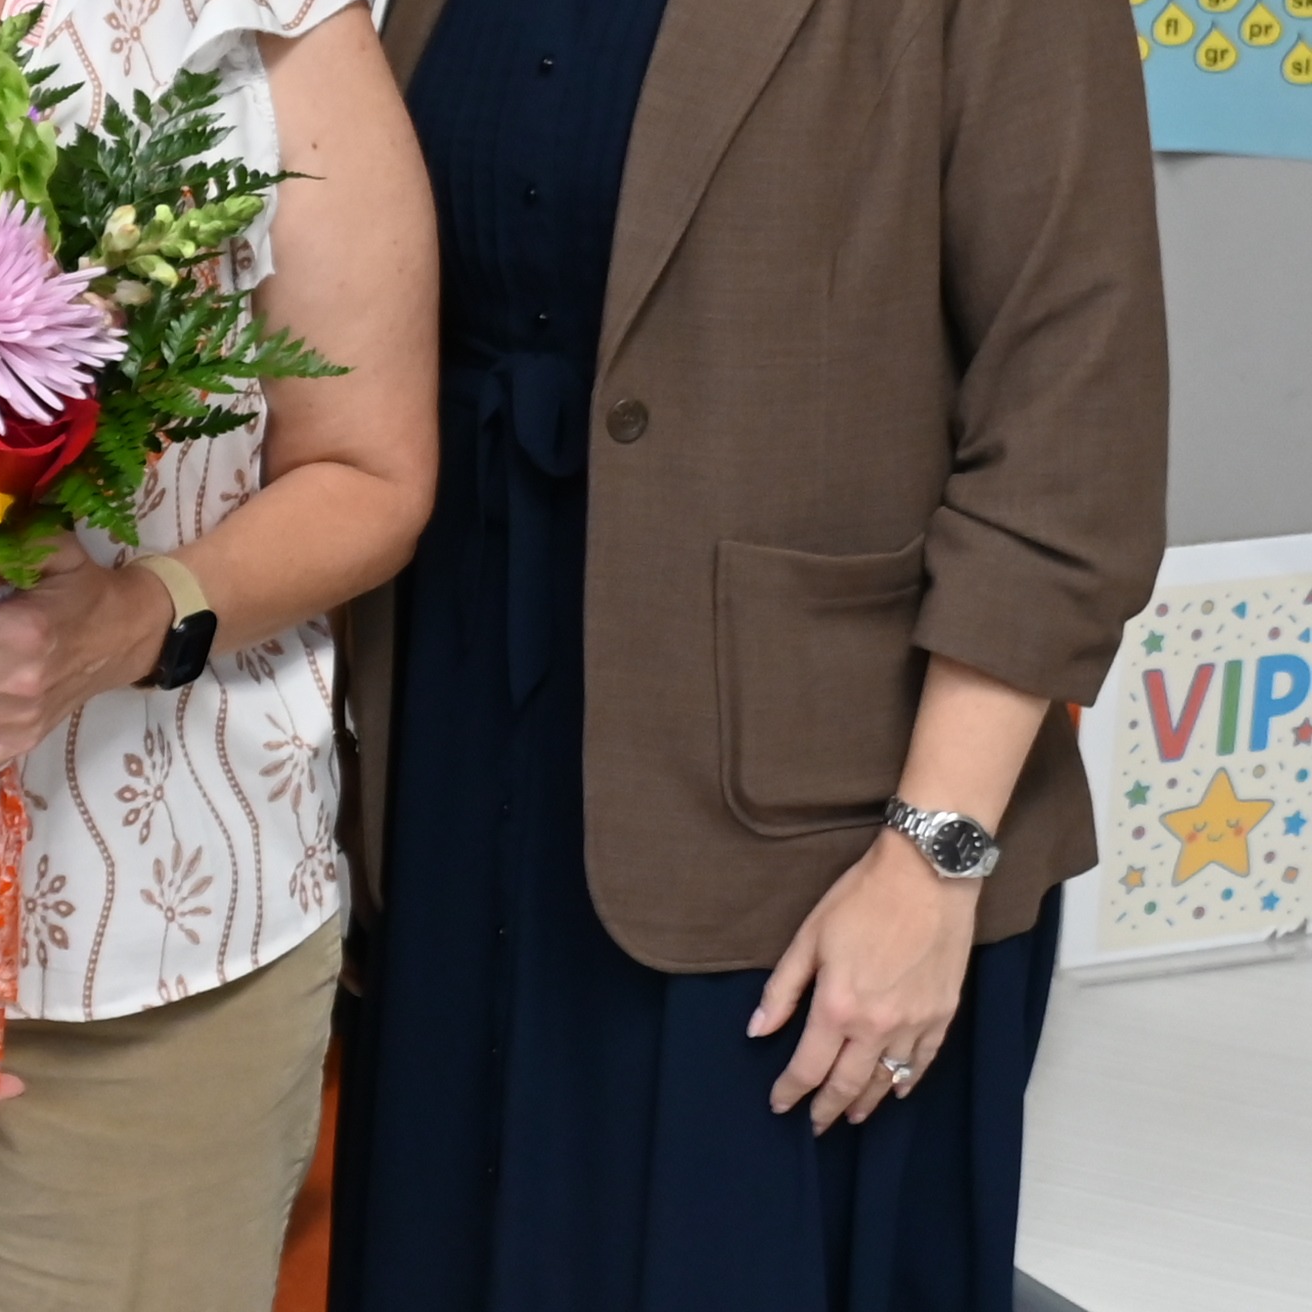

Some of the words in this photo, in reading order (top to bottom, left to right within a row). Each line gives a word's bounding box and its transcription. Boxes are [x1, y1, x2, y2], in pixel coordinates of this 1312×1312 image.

[1165, 19, 1178, 36] fl
[1249, 22, 1272, 40] pr
[1204, 47, 1229, 67] gr
[1142, 652, 1312, 763] VIP
